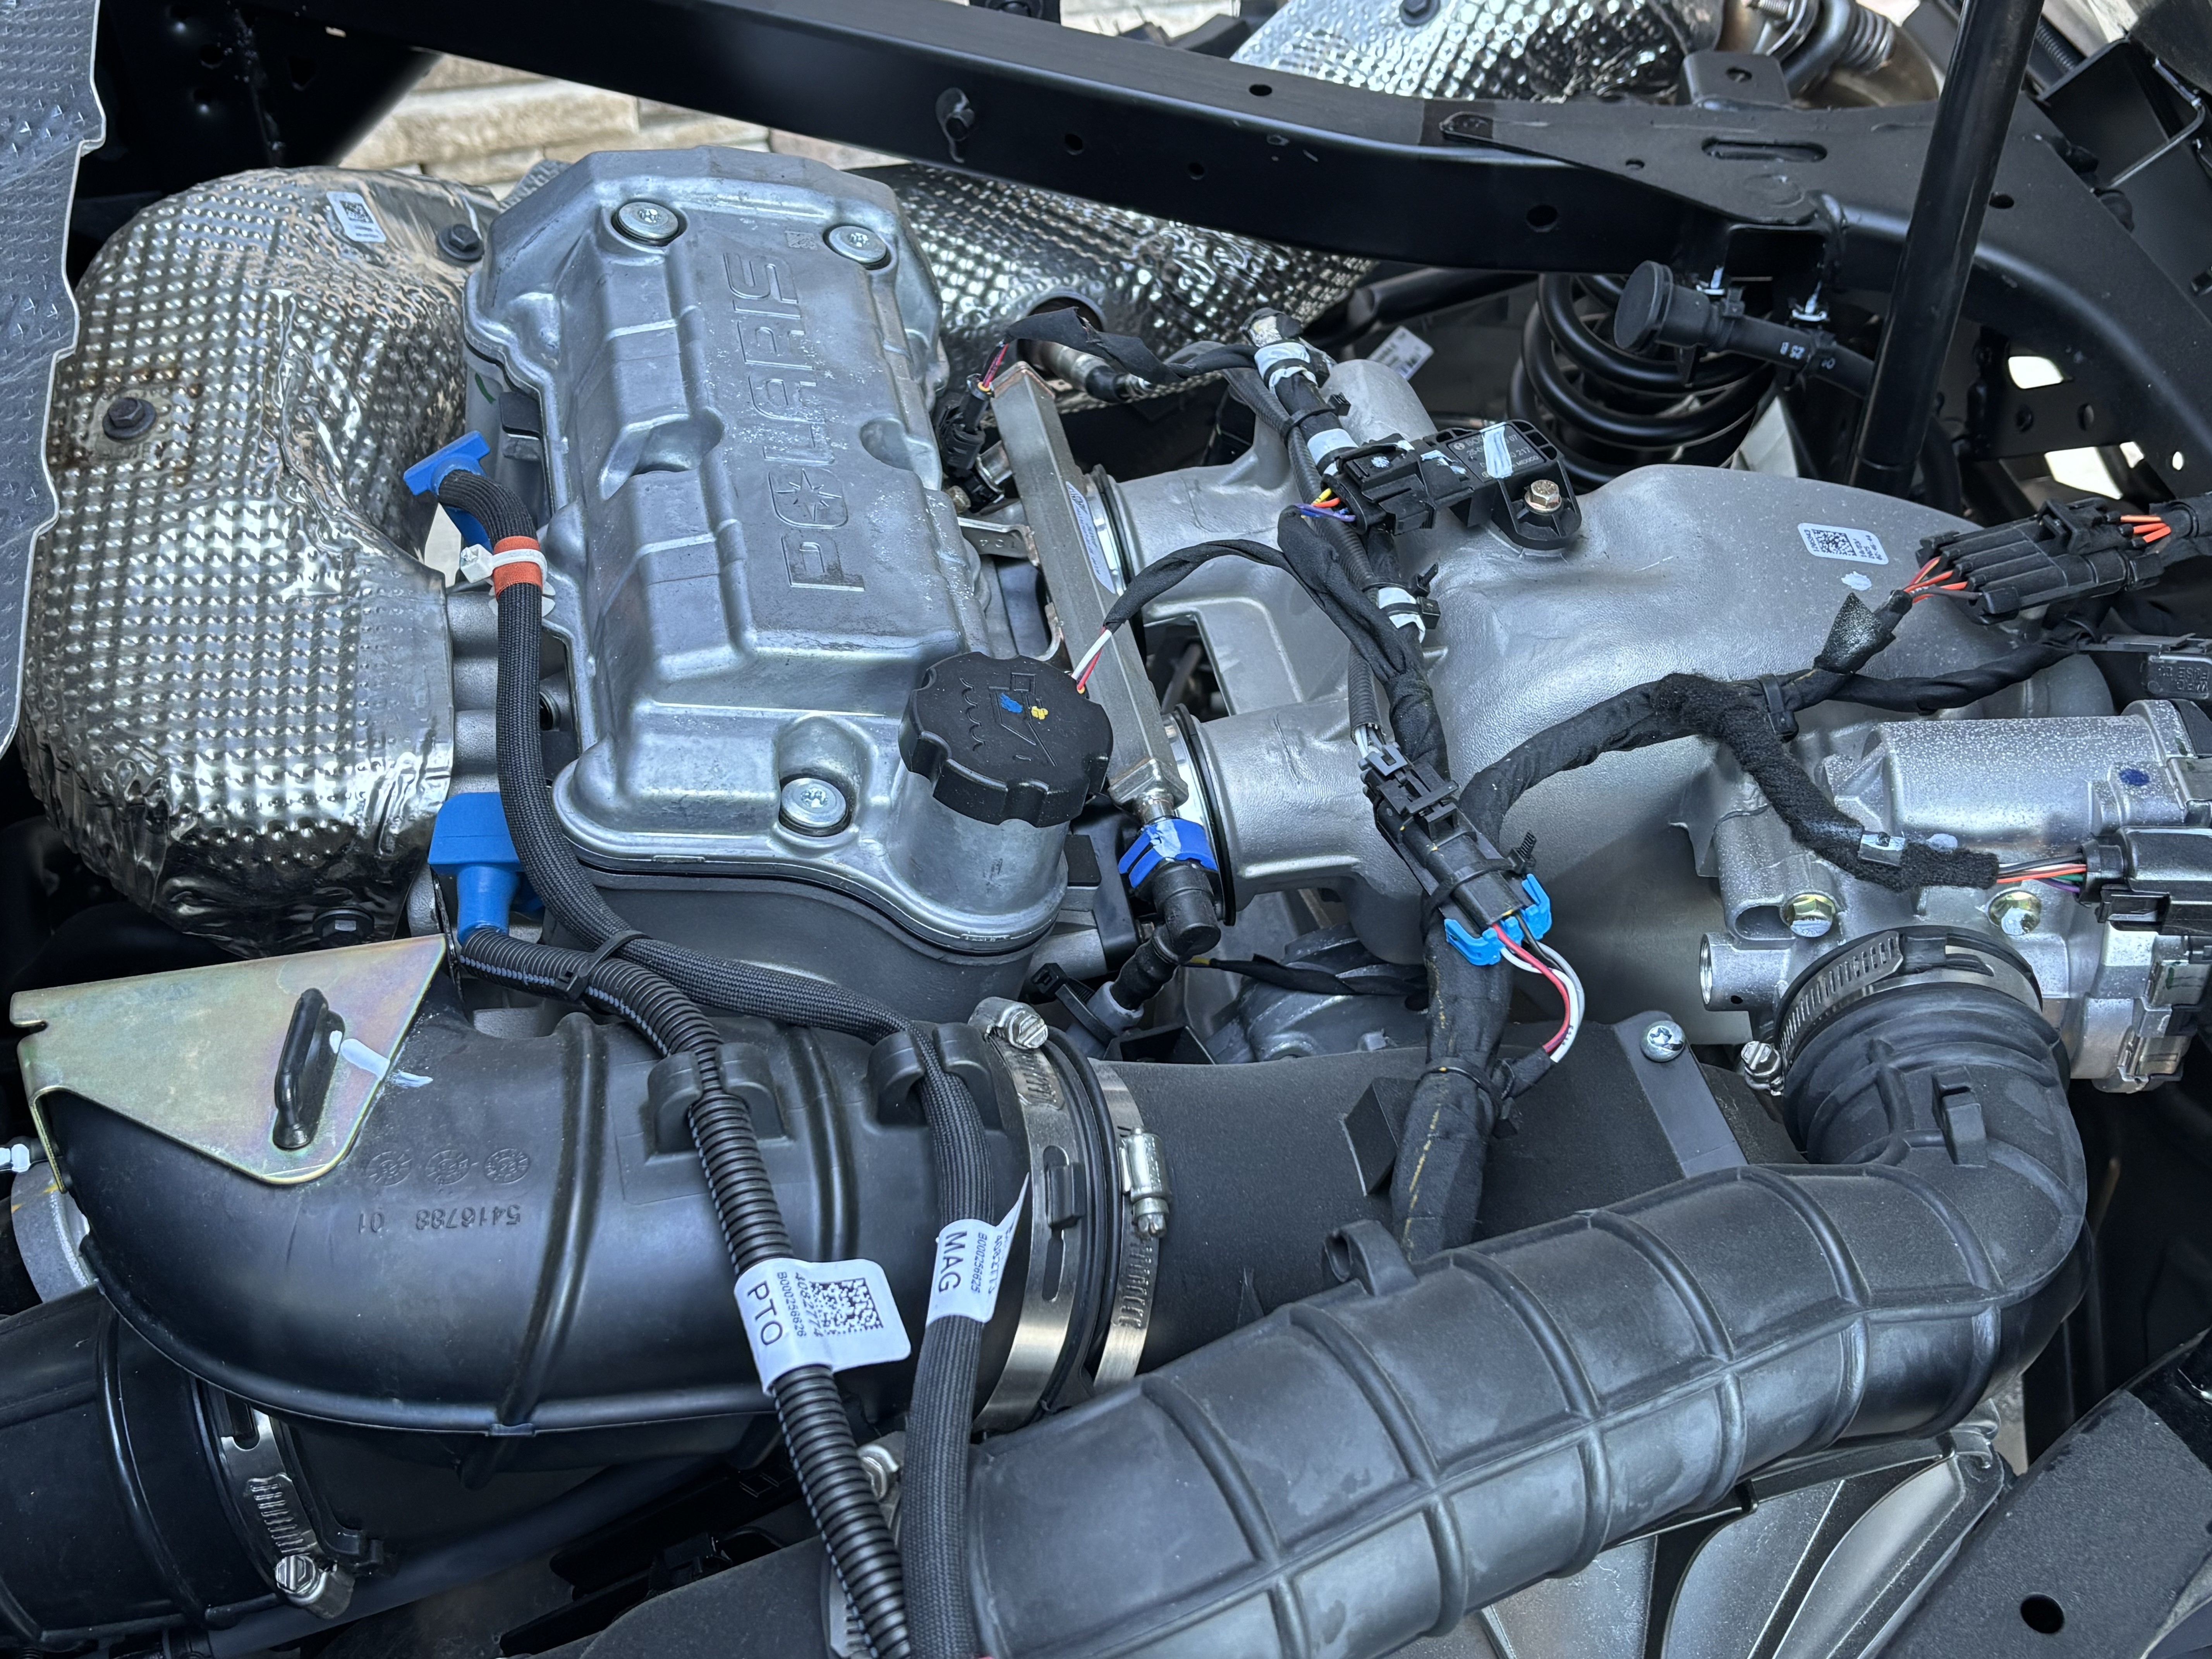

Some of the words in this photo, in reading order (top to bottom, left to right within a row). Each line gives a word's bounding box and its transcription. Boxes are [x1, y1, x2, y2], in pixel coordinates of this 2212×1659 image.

[723, 252, 865, 592] POLARIS
[1516, 447, 1531, 456] 217
[358, 1211, 385, 1233] 01
[416, 1204, 520, 1230] 5416788
[938, 1230, 968, 1293] MAG
[971, 1232, 987, 1293] B000256625
[747, 1281, 783, 1346] PTO
[776, 1271, 805, 1338] B000256626
[795, 1272, 822, 1338] 4082774
